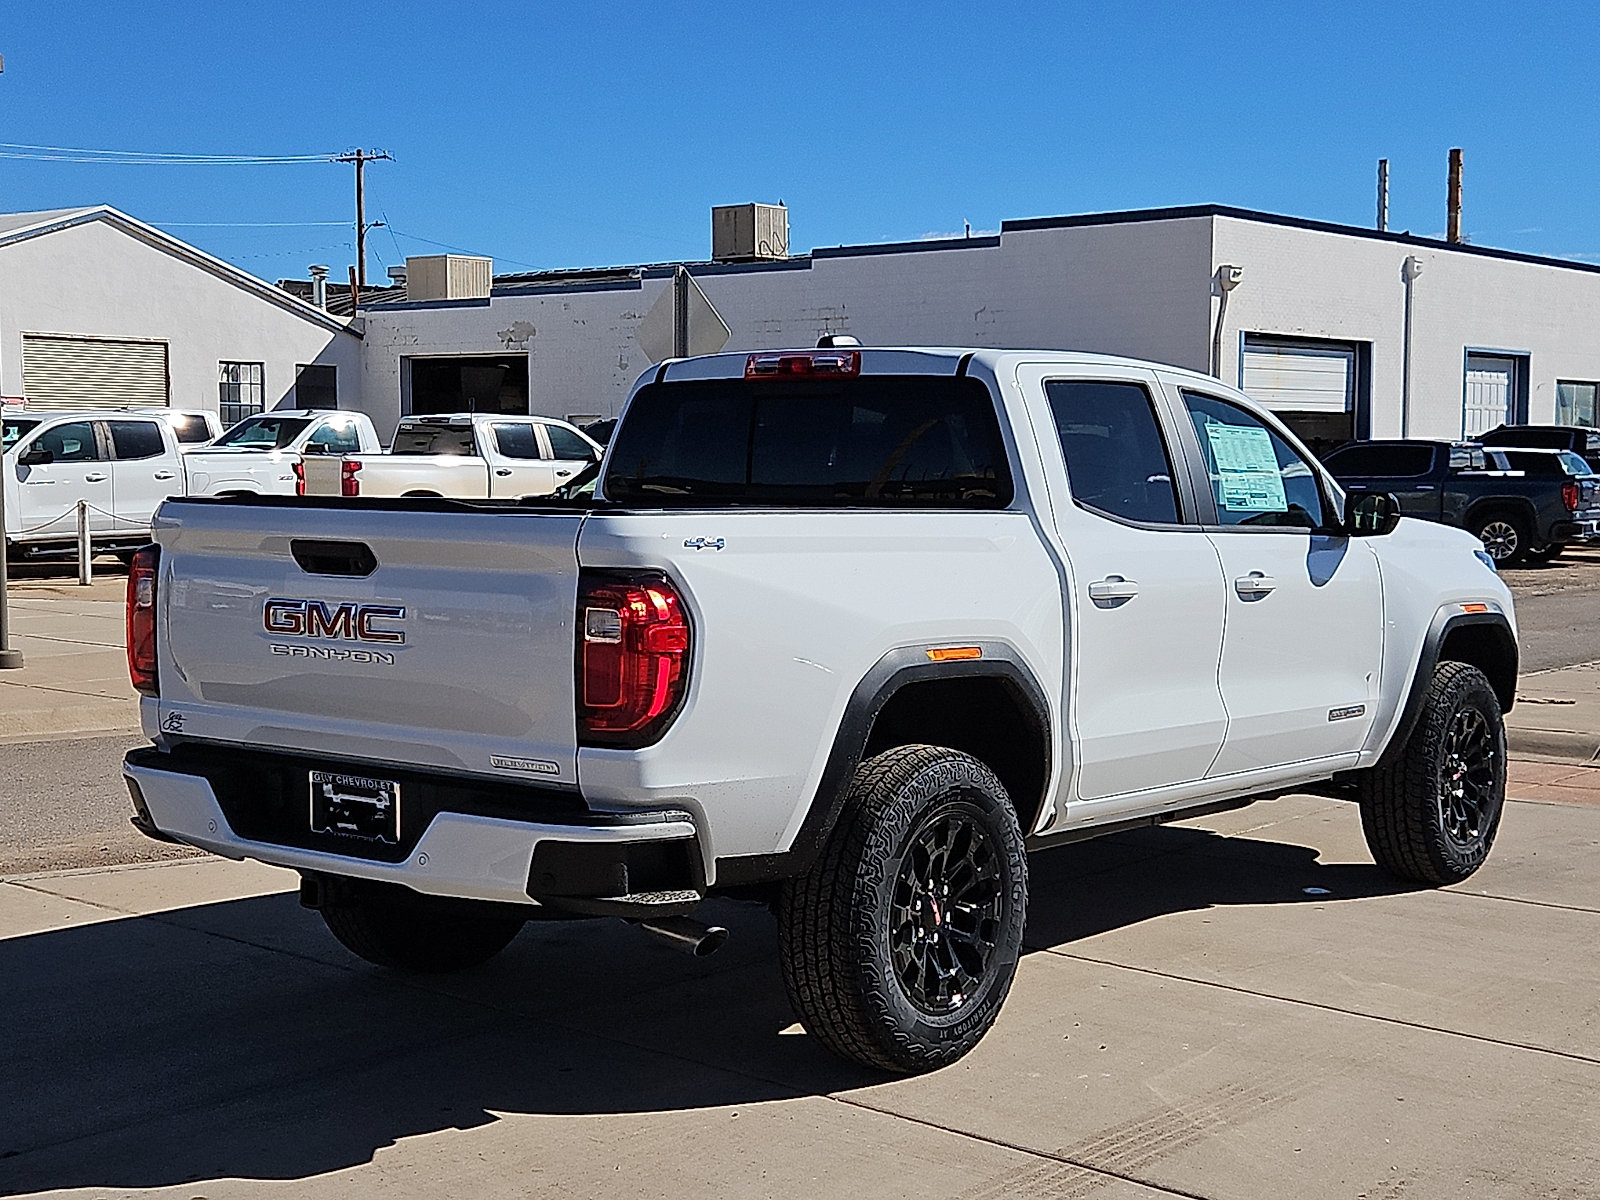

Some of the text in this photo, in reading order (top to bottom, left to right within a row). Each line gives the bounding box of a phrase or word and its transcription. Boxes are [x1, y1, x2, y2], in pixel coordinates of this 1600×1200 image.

[263, 597, 406, 644] GMC
[269, 643, 395, 665] CANYON
[335, 776, 391, 791] CHEVROLET
